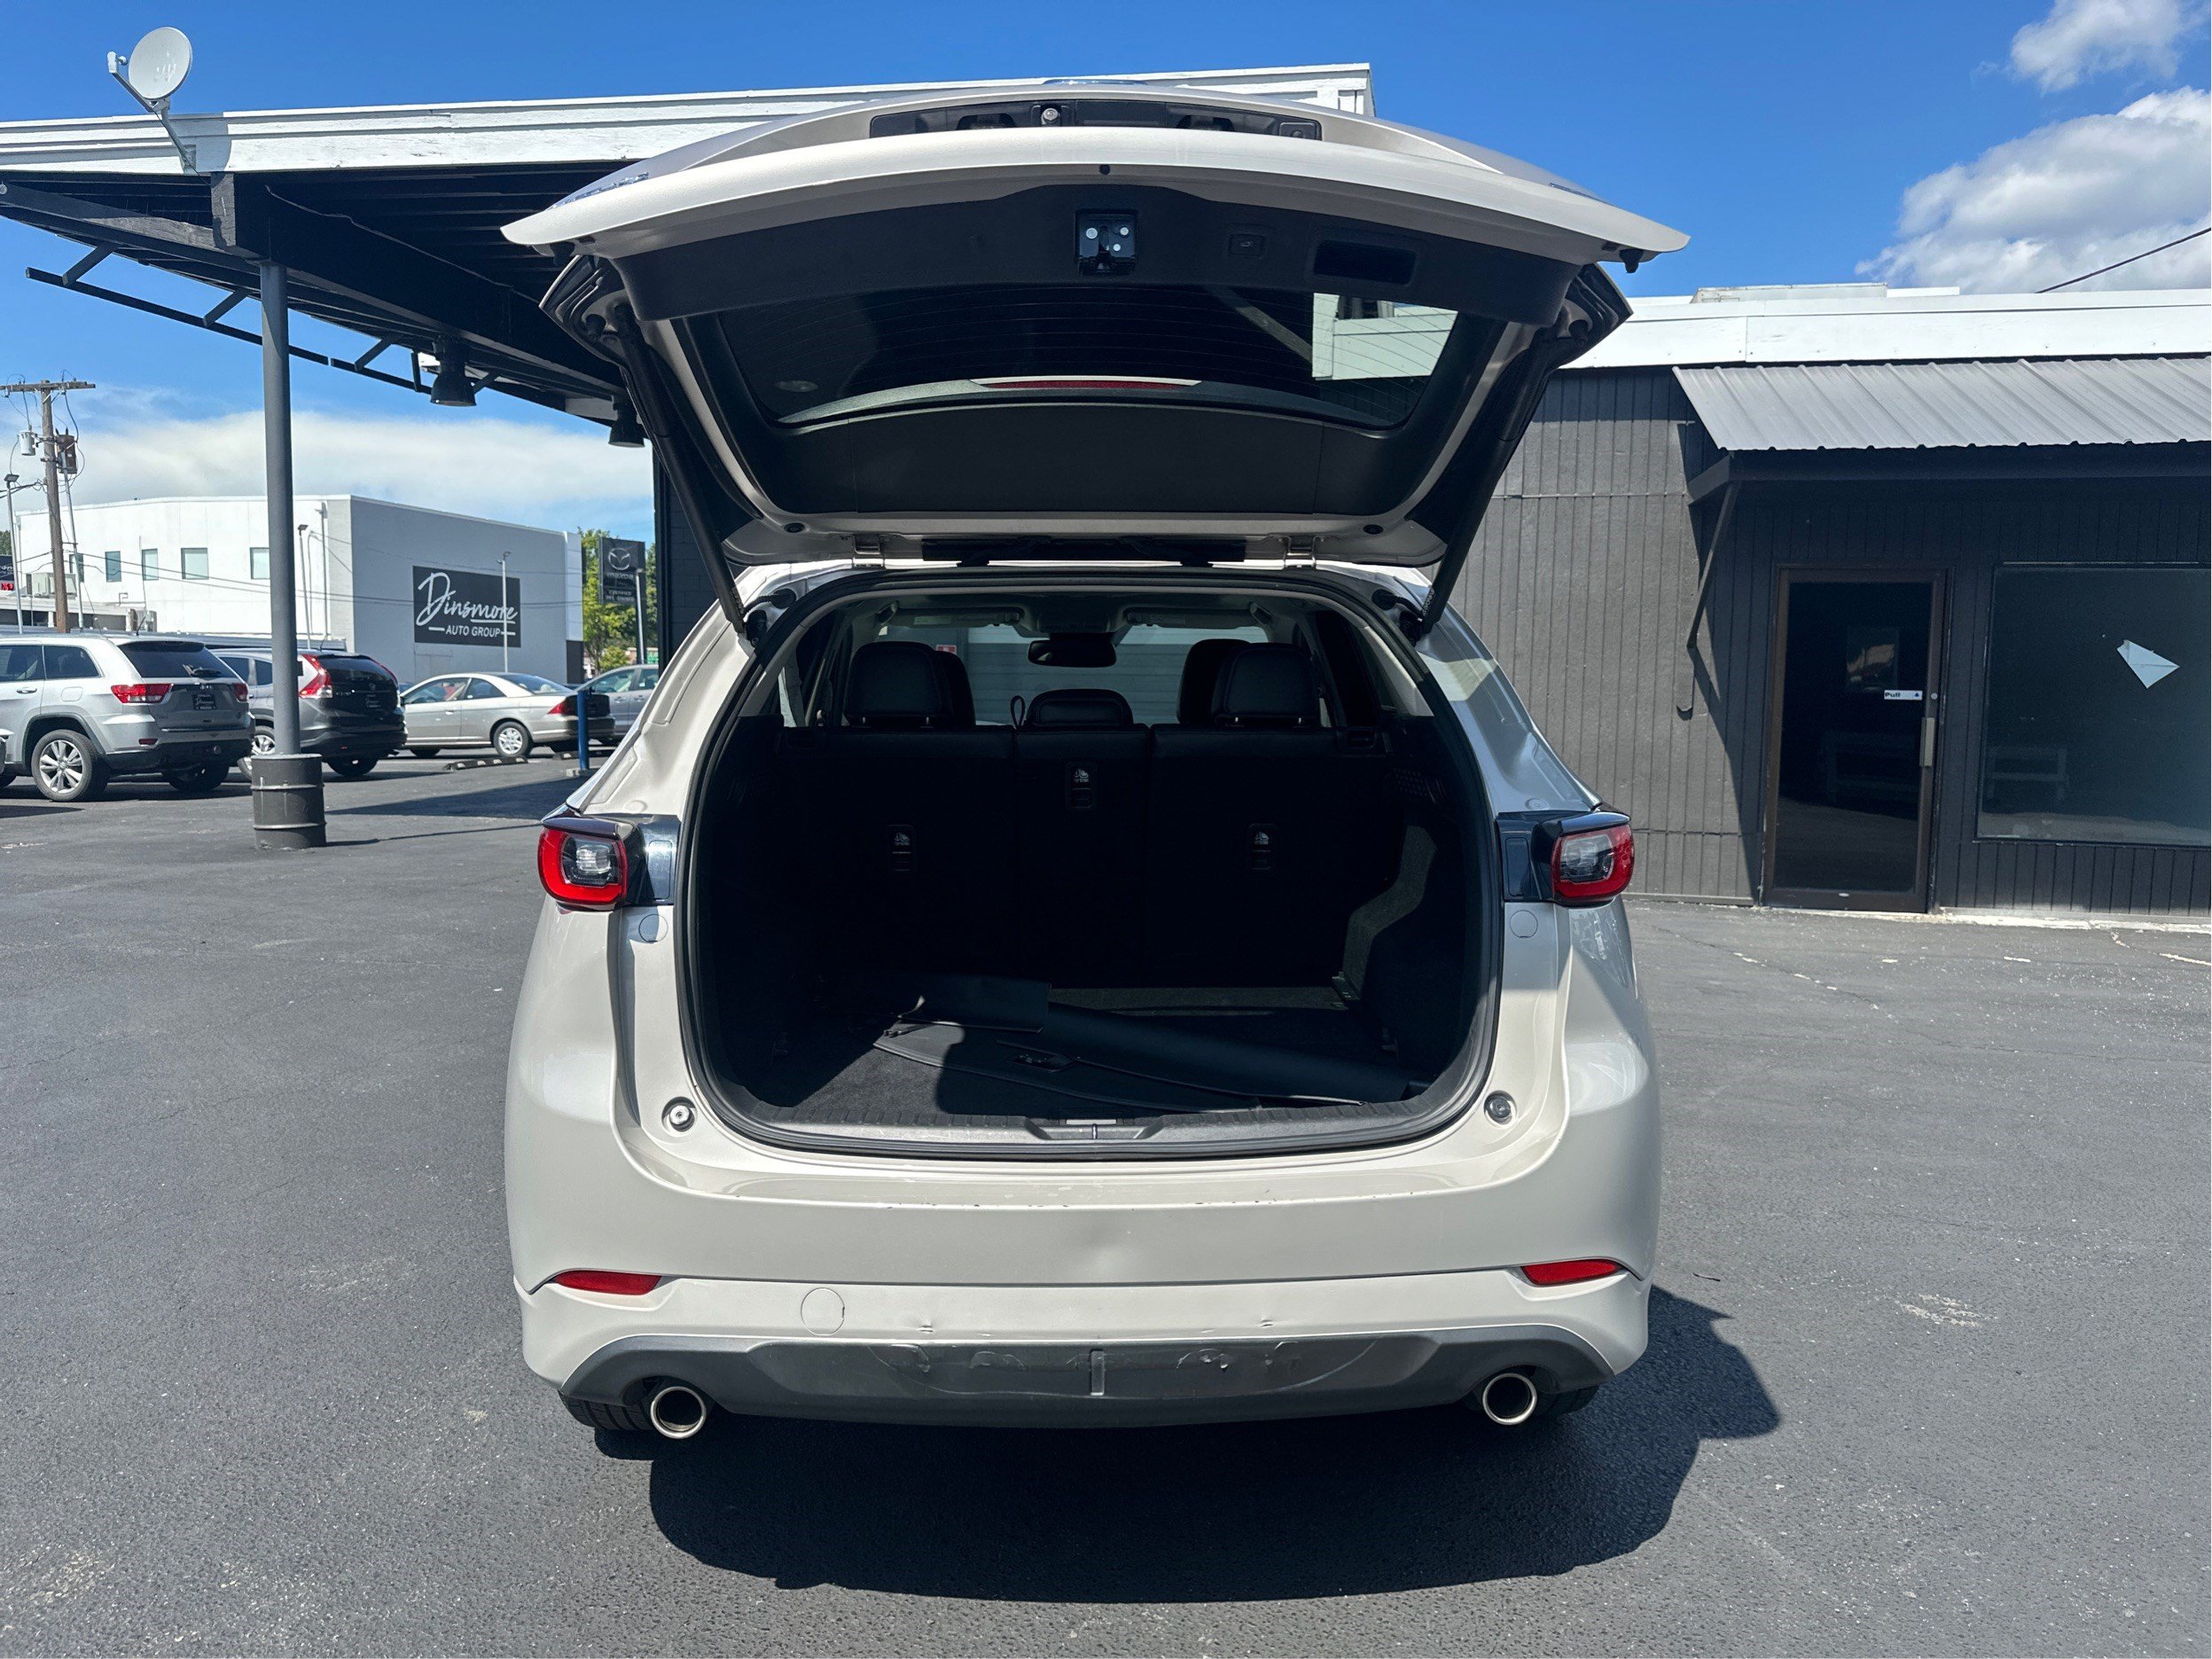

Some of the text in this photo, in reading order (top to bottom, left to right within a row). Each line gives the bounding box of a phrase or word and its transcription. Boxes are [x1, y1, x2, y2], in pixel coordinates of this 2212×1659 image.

[416, 572, 518, 626] Dinsmore
[445, 624, 501, 638] AUTO GROUP
